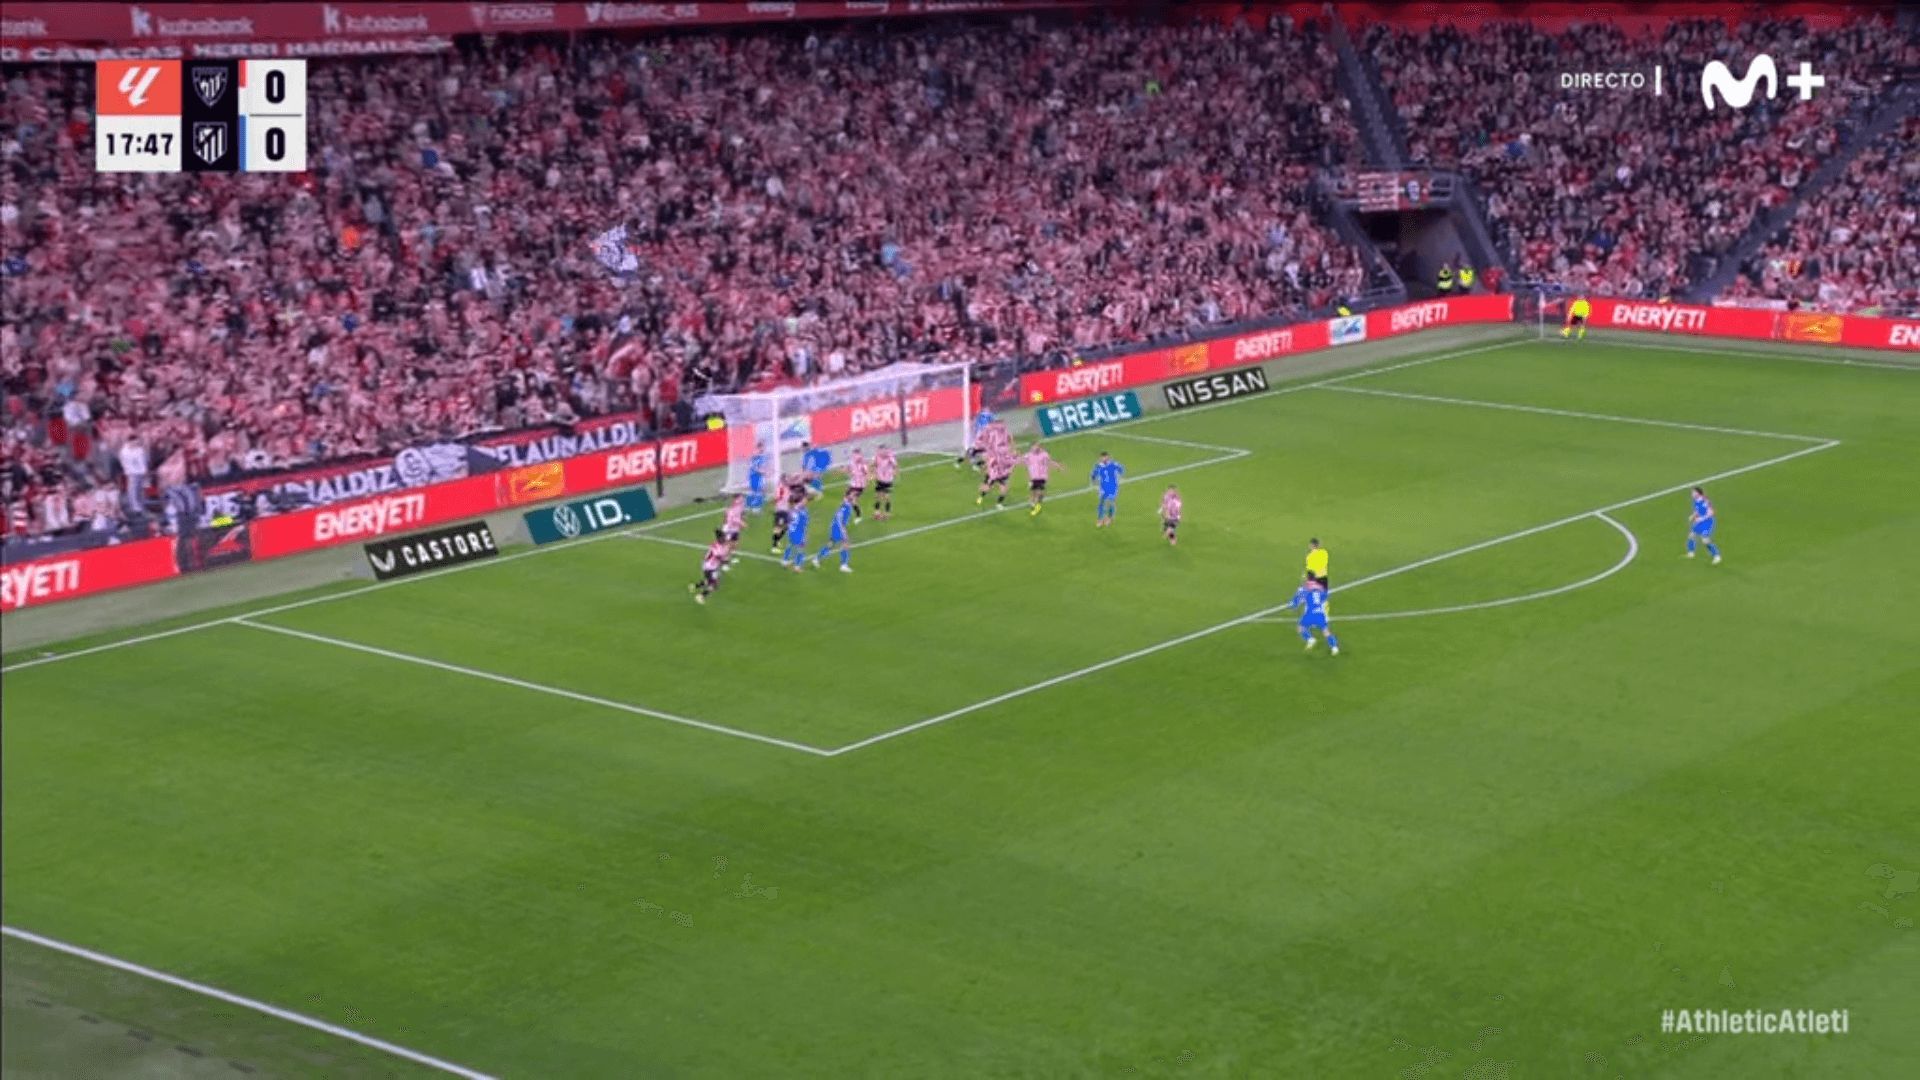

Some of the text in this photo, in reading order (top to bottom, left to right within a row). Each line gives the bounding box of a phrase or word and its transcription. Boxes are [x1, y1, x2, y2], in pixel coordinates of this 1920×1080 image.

[1612, 303, 1707, 331] ENERYETI
[1888, 324, 1920, 346] EN
[1166, 369, 1267, 406] NISSAN
[1063, 395, 1133, 432] REALE
[313, 494, 425, 541] ENERYETI
[583, 498, 632, 530] ID.
[402, 529, 495, 567] CASTORE
